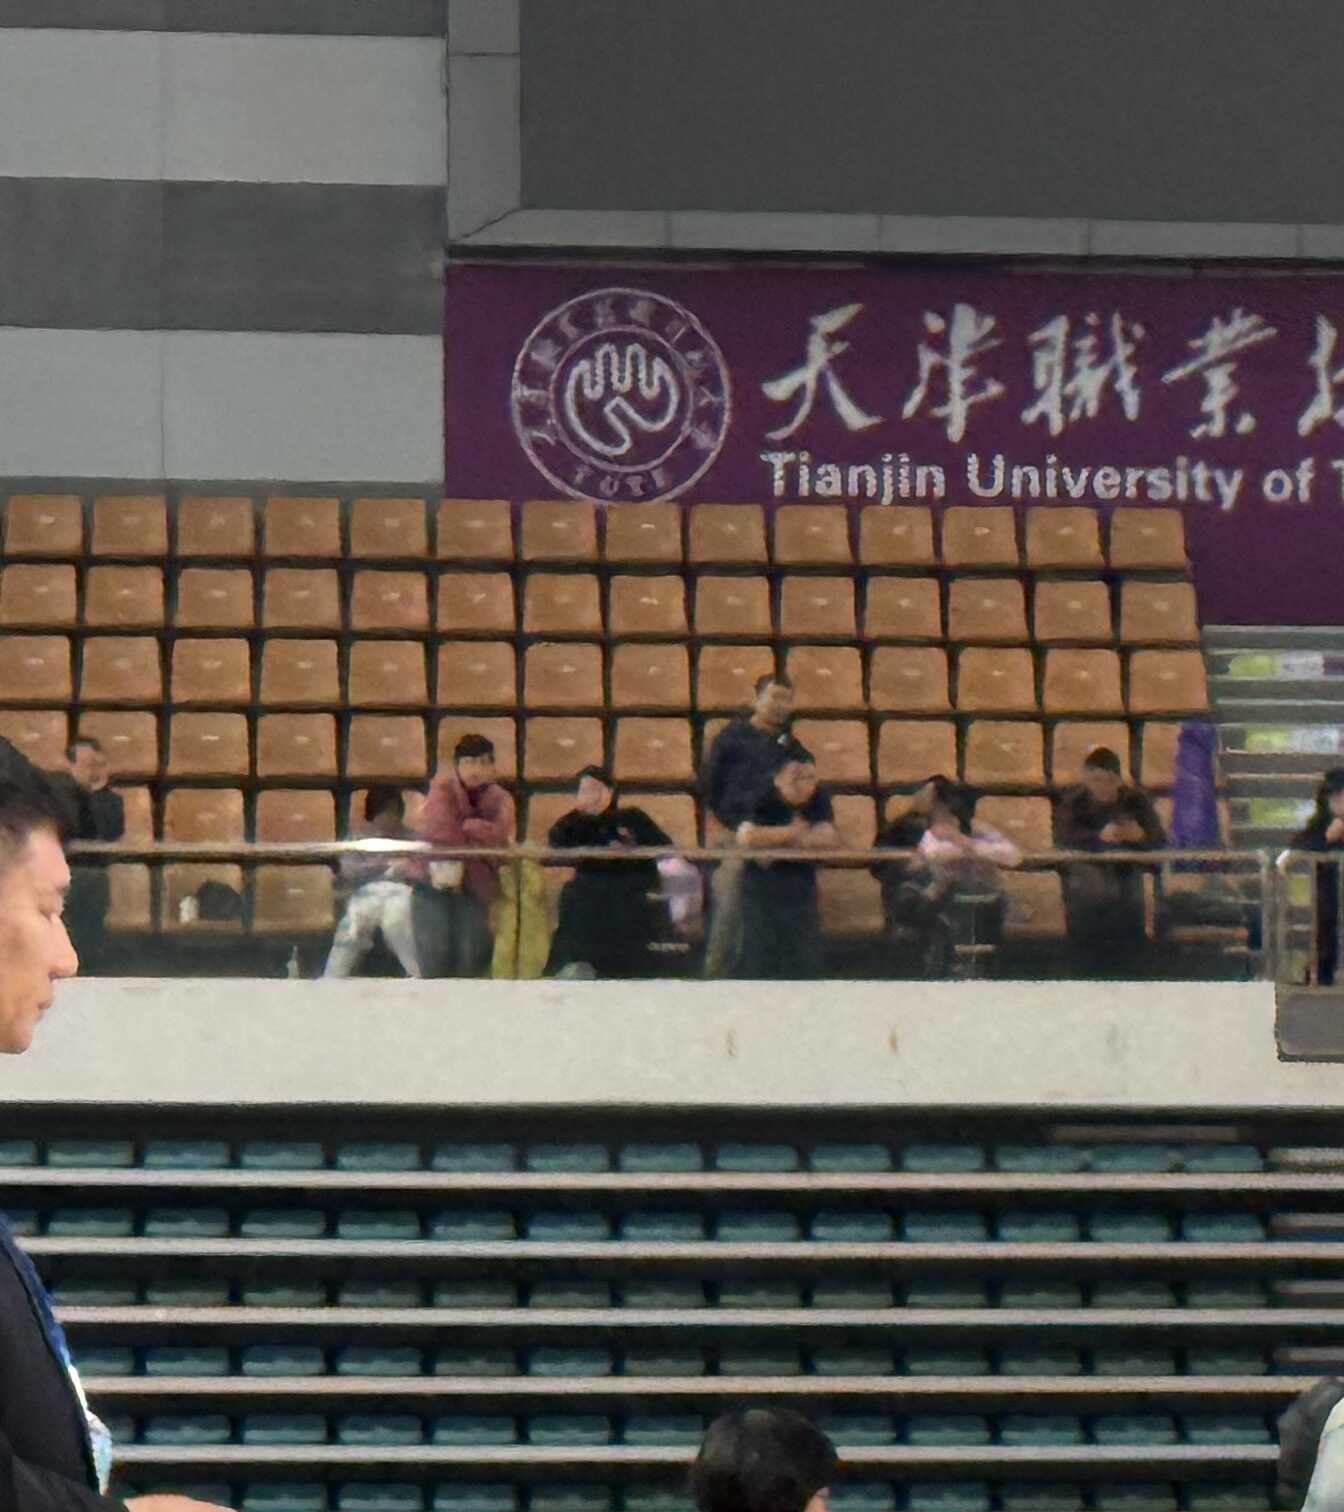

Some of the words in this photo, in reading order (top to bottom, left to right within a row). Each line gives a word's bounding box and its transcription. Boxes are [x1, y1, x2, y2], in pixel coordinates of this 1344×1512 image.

[761, 451, 946, 505] Tianjin
[966, 453, 1242, 510] University
[1262, 457, 1314, 501] of
